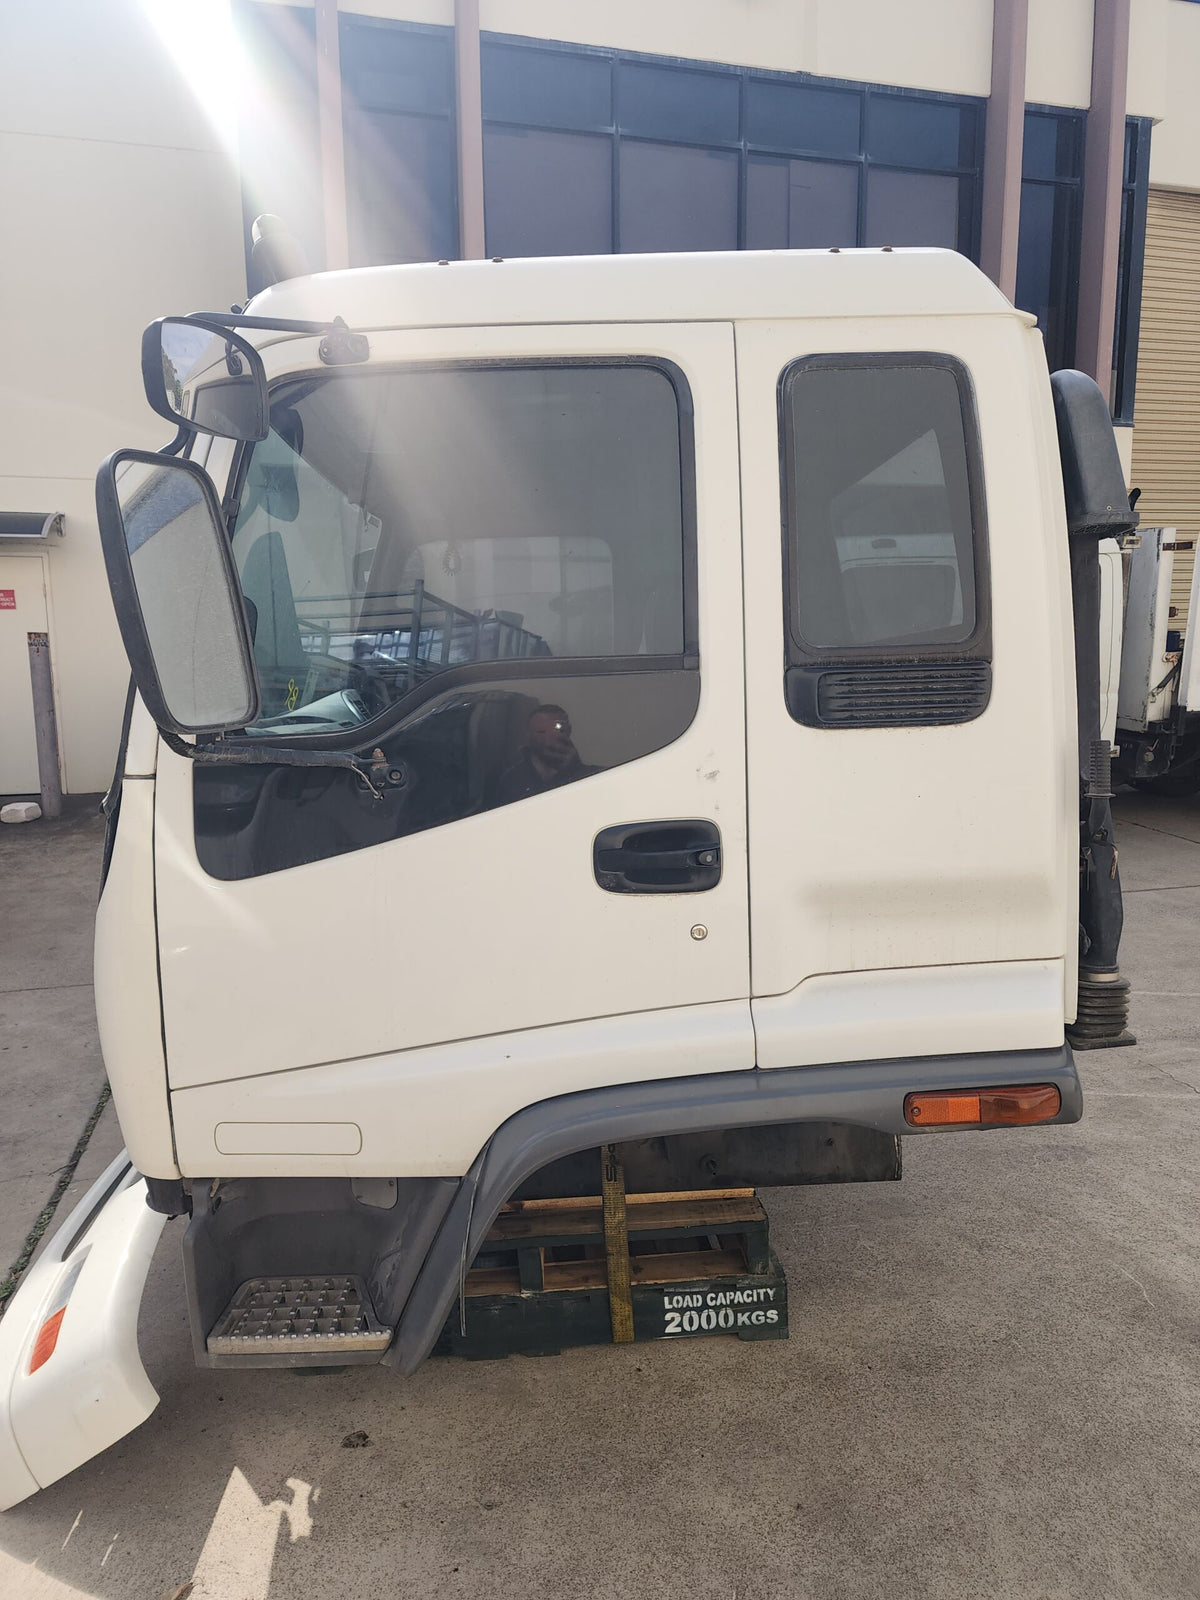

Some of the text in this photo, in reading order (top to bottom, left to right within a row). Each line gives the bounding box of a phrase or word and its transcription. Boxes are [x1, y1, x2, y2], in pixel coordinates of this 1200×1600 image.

[664, 1287, 776, 1309] LOAD CAPACITY
[664, 1307, 779, 1333] 2000 KGS
